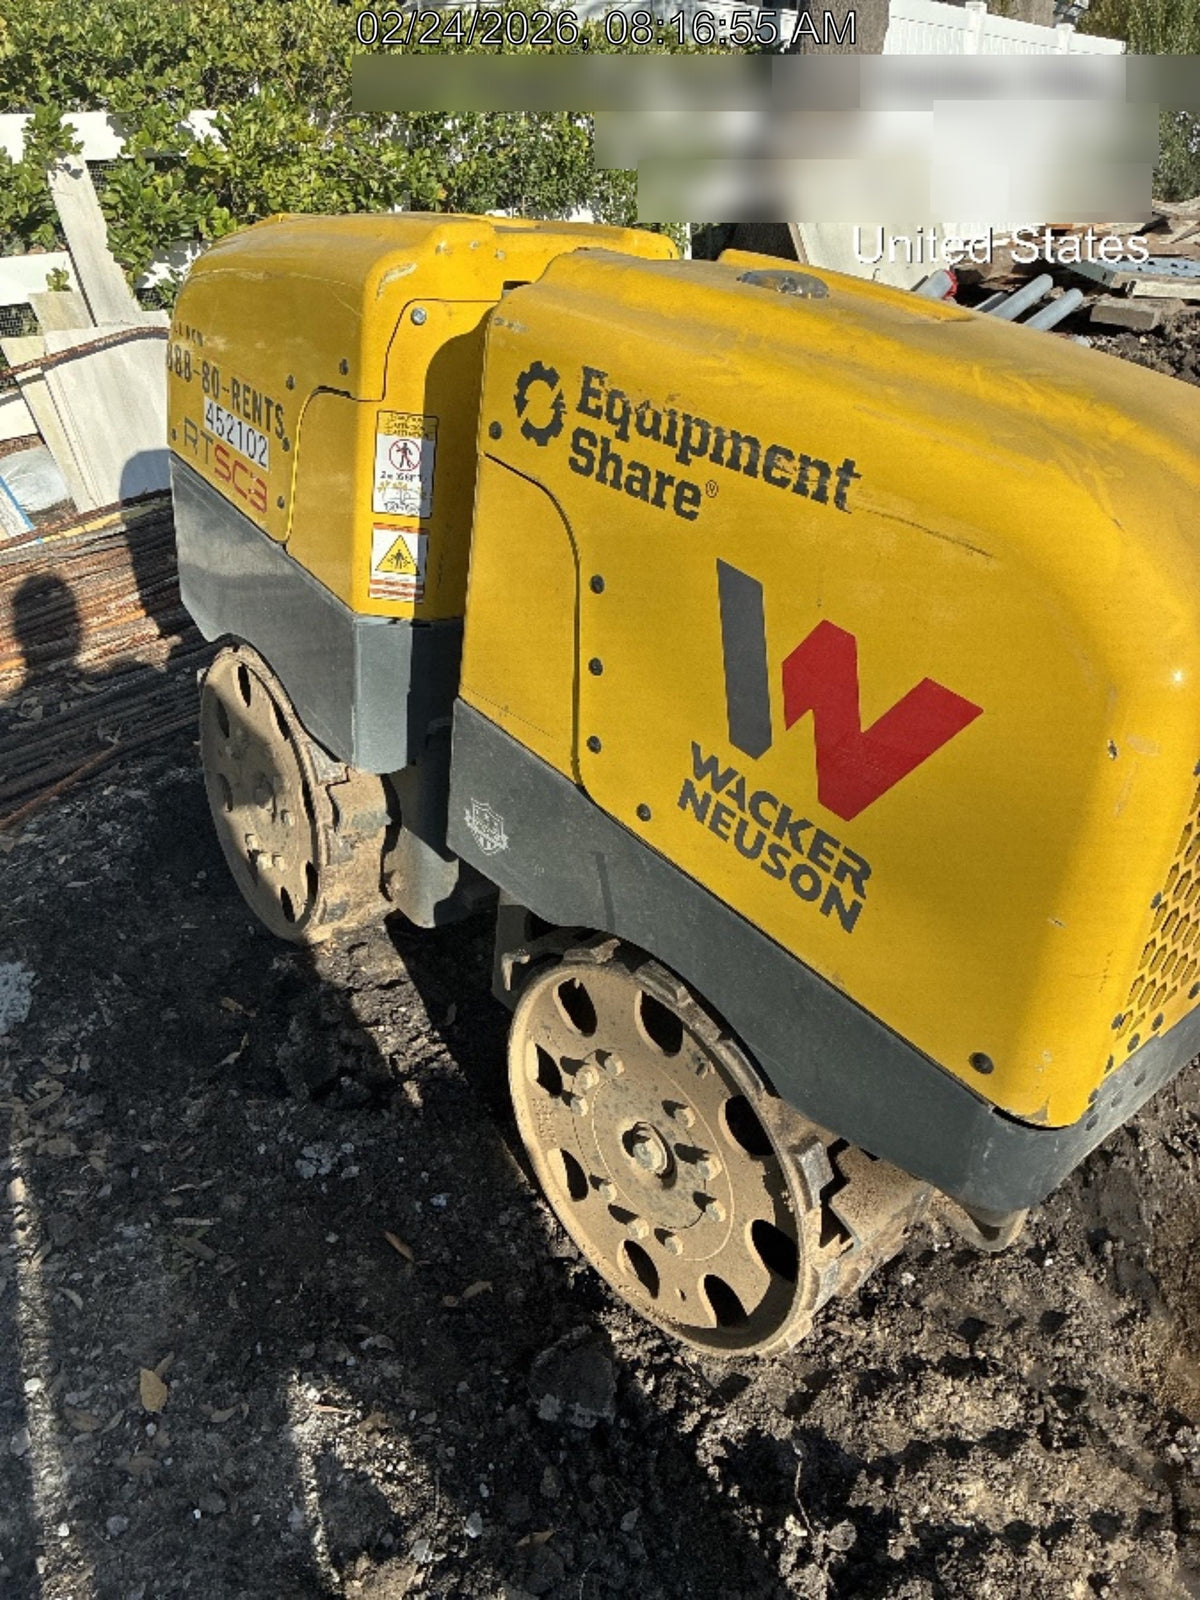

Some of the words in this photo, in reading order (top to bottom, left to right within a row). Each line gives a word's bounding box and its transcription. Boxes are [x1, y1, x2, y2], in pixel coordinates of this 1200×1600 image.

[206, 402, 267, 468] 452102
[568, 427, 702, 521] Share
[576, 366, 862, 513] Equipment
[677, 778, 863, 934] NEUSON
[691, 740, 872, 900] WACKER
